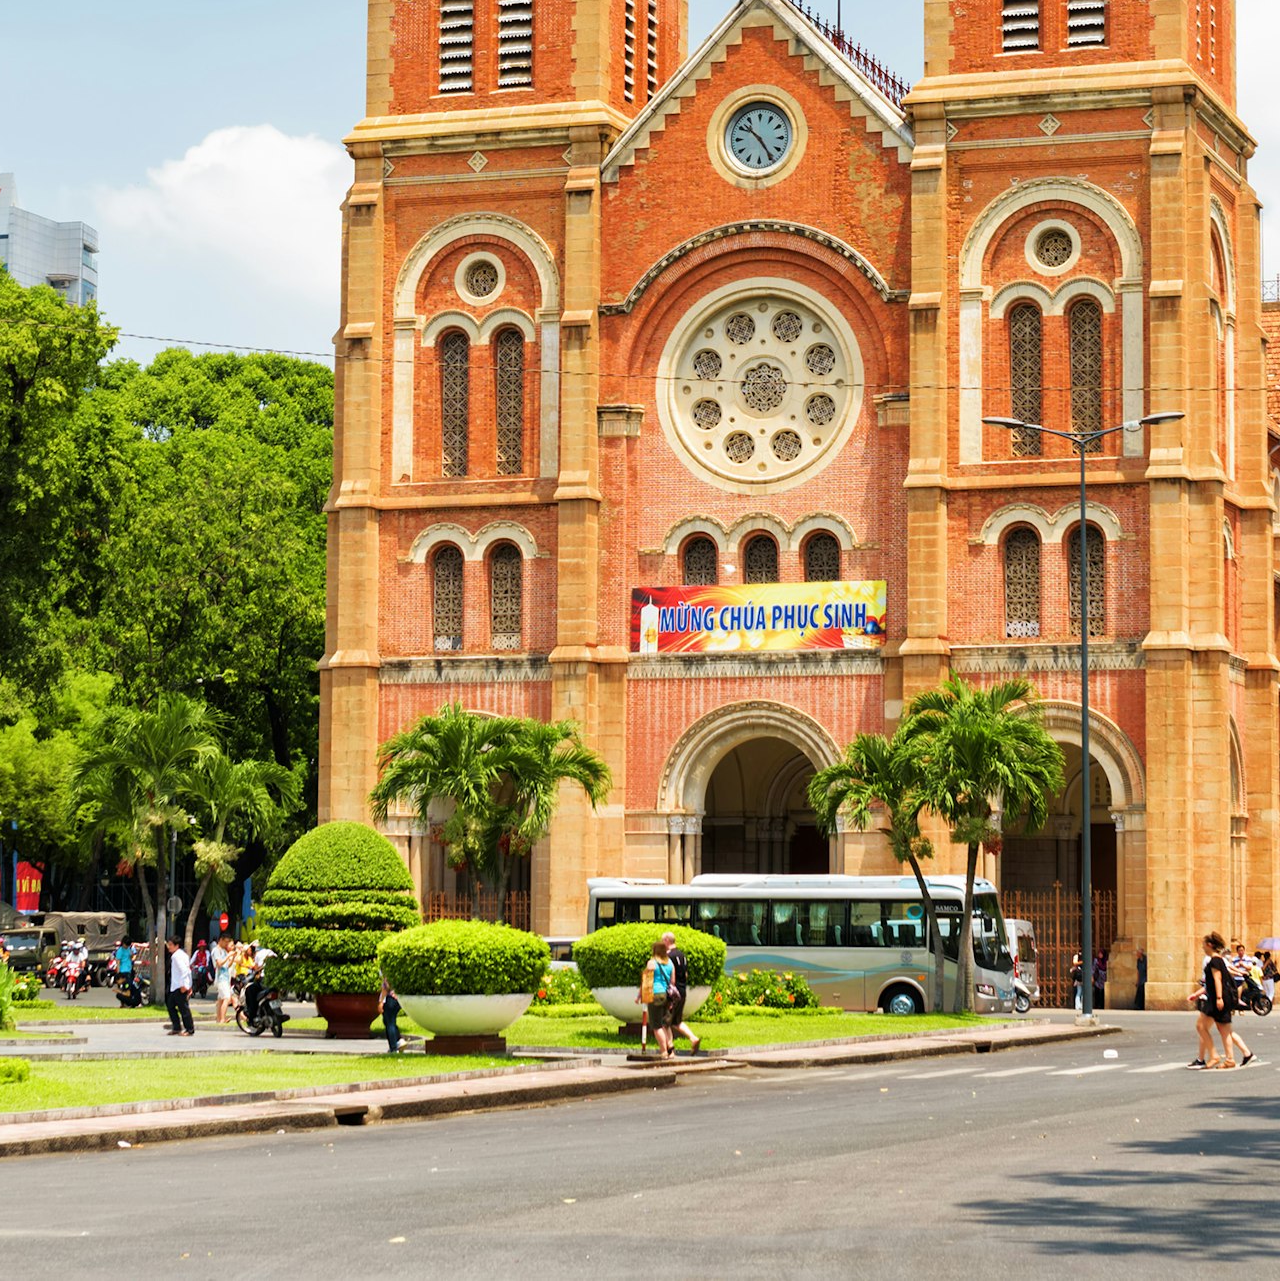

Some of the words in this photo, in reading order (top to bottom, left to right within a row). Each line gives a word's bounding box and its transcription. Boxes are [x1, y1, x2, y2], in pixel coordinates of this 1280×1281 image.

[659, 601, 715, 633] MỪNG
[719, 600, 766, 631] CHÚA
[772, 604, 820, 637] PHỤC
[823, 602, 867, 629] SINH
